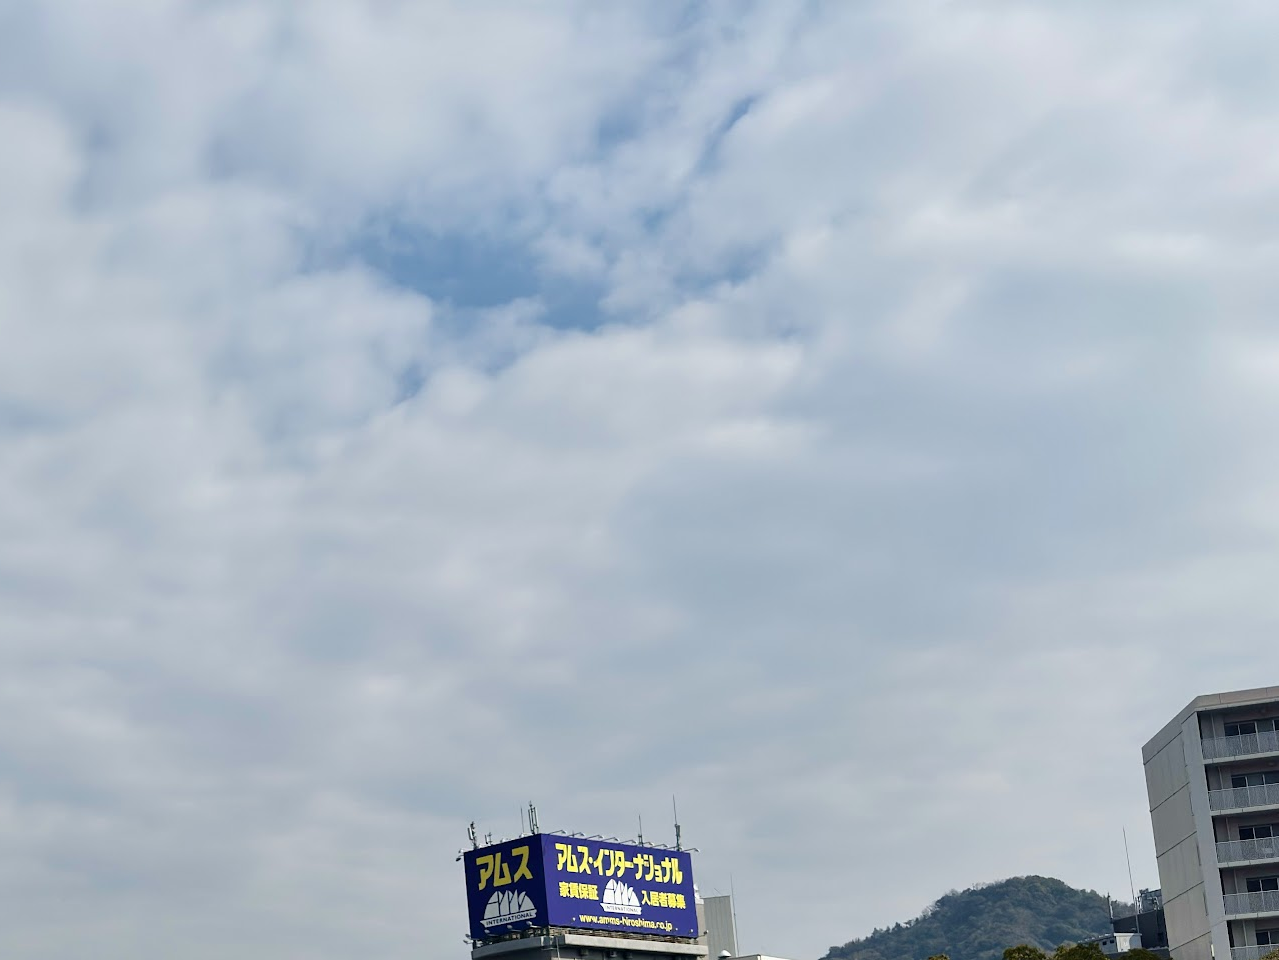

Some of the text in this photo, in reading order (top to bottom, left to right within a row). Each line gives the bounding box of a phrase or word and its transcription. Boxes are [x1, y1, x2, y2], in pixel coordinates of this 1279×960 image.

[475, 845, 534, 891] アムス
[554, 842, 683, 885] アムス・インターナショナル
[558, 881, 599, 901] 家賃保証
[641, 889, 686, 910] 入居者募集
[485, 911, 534, 926] INTERNATIONAL
[578, 914, 673, 932] www.amms-hiroshima.co.jp
